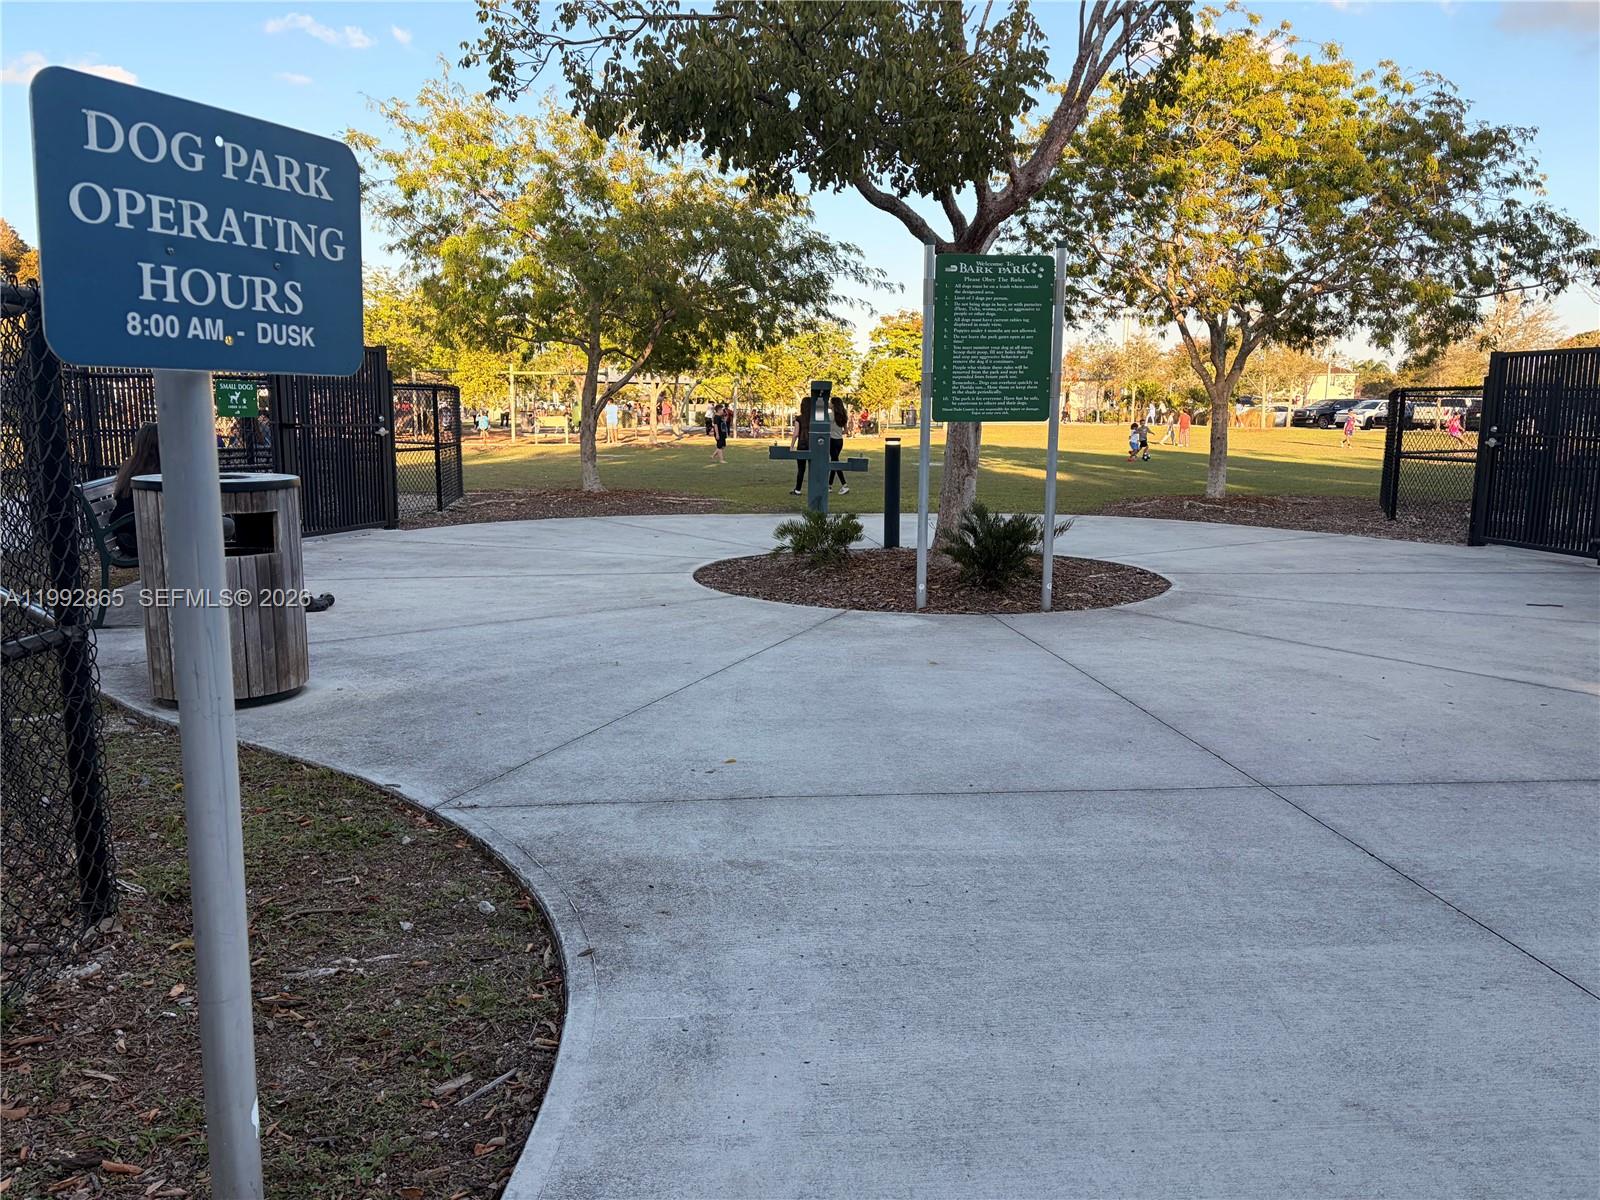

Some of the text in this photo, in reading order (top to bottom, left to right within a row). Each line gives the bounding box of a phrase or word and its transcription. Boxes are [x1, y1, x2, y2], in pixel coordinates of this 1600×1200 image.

[81, 108, 334, 201] DOG PARK
[68, 182, 346, 261] OPERATING
[137, 262, 305, 316] HOURS
[959, 262, 1031, 274] BARK PARK
[126, 311, 180, 338] 8:00
[256, 321, 316, 347] DUSK
[237, 383, 254, 391] DOGS
